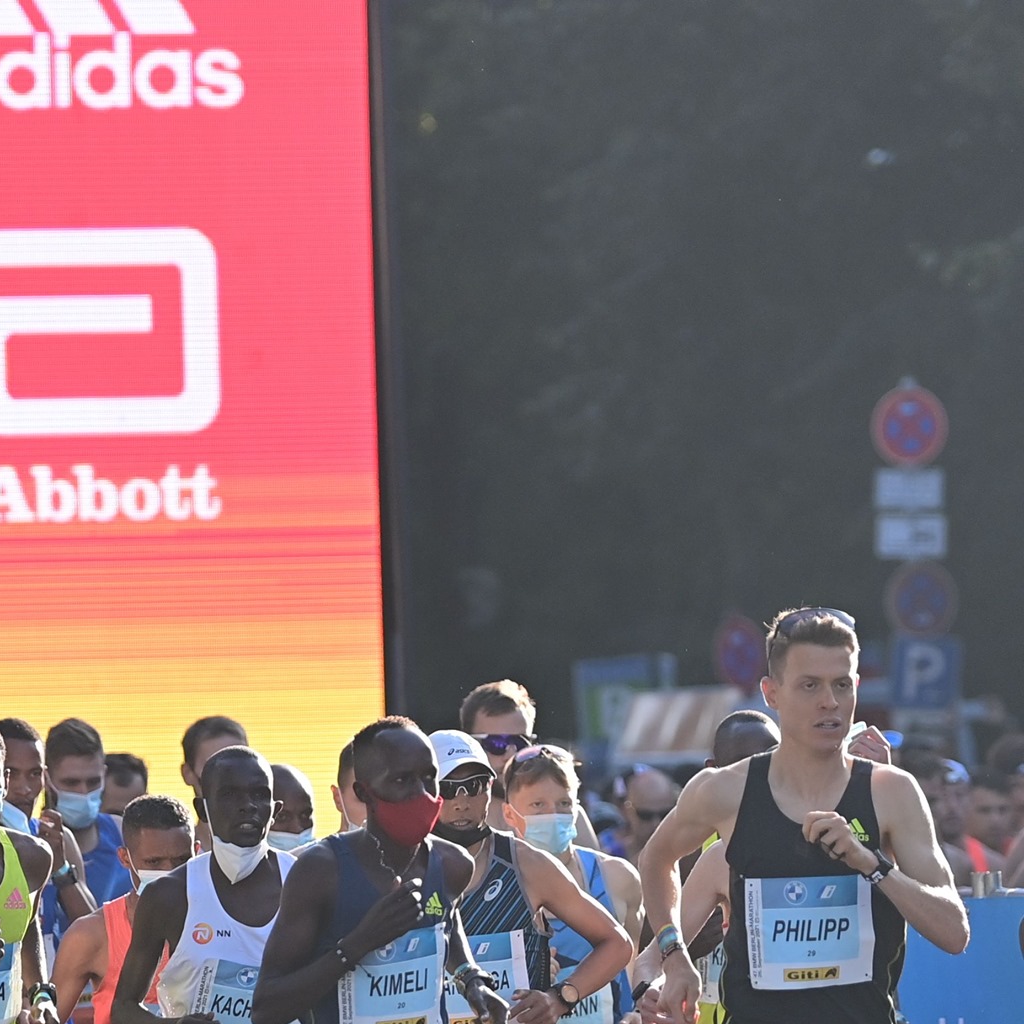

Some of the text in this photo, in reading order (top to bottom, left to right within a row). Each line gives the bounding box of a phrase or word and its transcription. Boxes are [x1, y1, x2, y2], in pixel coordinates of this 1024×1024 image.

[216, 930, 231, 938] NN
[772, 917, 850, 942] PHILIPP
[369, 967, 428, 997] KIMELI
[787, 970, 819, 980] Giti
